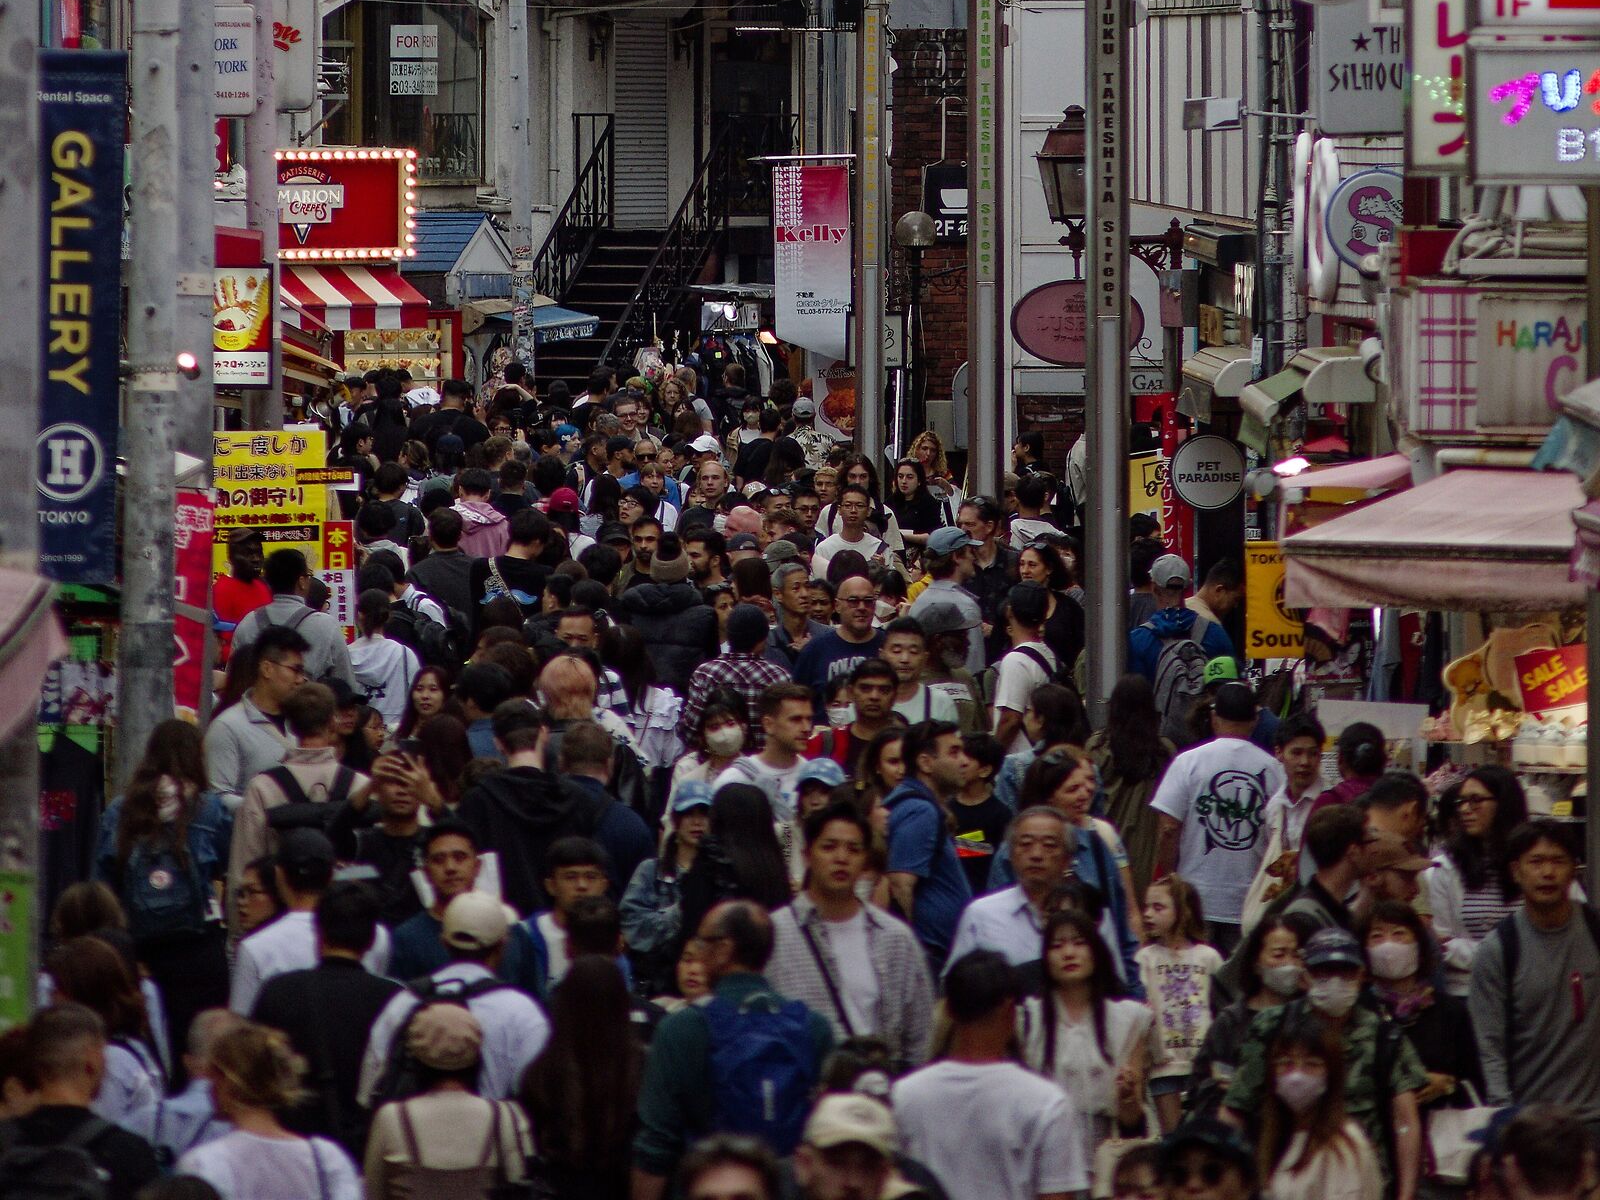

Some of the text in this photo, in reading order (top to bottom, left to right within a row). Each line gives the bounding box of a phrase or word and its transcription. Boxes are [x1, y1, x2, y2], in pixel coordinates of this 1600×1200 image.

[396, 35, 420, 48] FOR
[75, 91, 112, 104] Space
[980, 83, 991, 190] TAKESHITA
[1103, 72, 1115, 203] TAKESHITA
[280, 166, 326, 182] PATISSERIE
[278, 189, 341, 205] MARION
[776, 224, 847, 245] Kelly
[48, 130, 97, 396] GALLERY
[1197, 461, 1221, 471] PET
[1178, 472, 1241, 483] PARADISE
[37, 510, 89, 525] TOKYO
[327, 528, 348, 570] 本日
[1522, 654, 1567, 692] SALE
[1545, 665, 1588, 704] SALE
